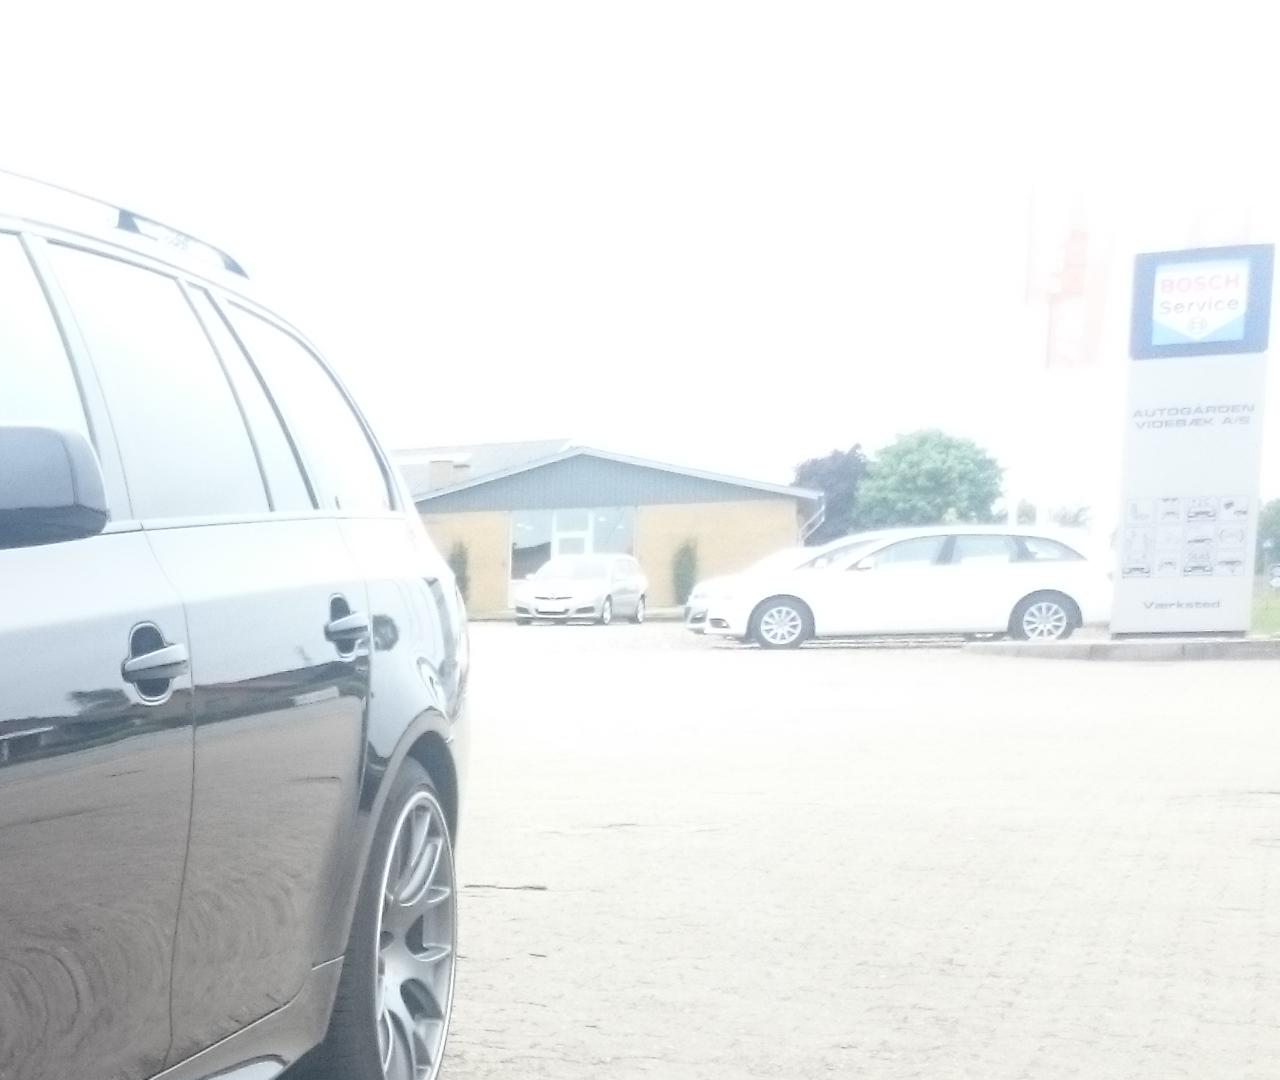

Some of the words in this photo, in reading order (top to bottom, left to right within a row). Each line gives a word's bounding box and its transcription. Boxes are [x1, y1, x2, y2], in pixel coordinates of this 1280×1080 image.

[1160, 274, 1240, 295] BOSCH
[1159, 297, 1239, 315] Service
[1143, 600, 1220, 610] Værksted
